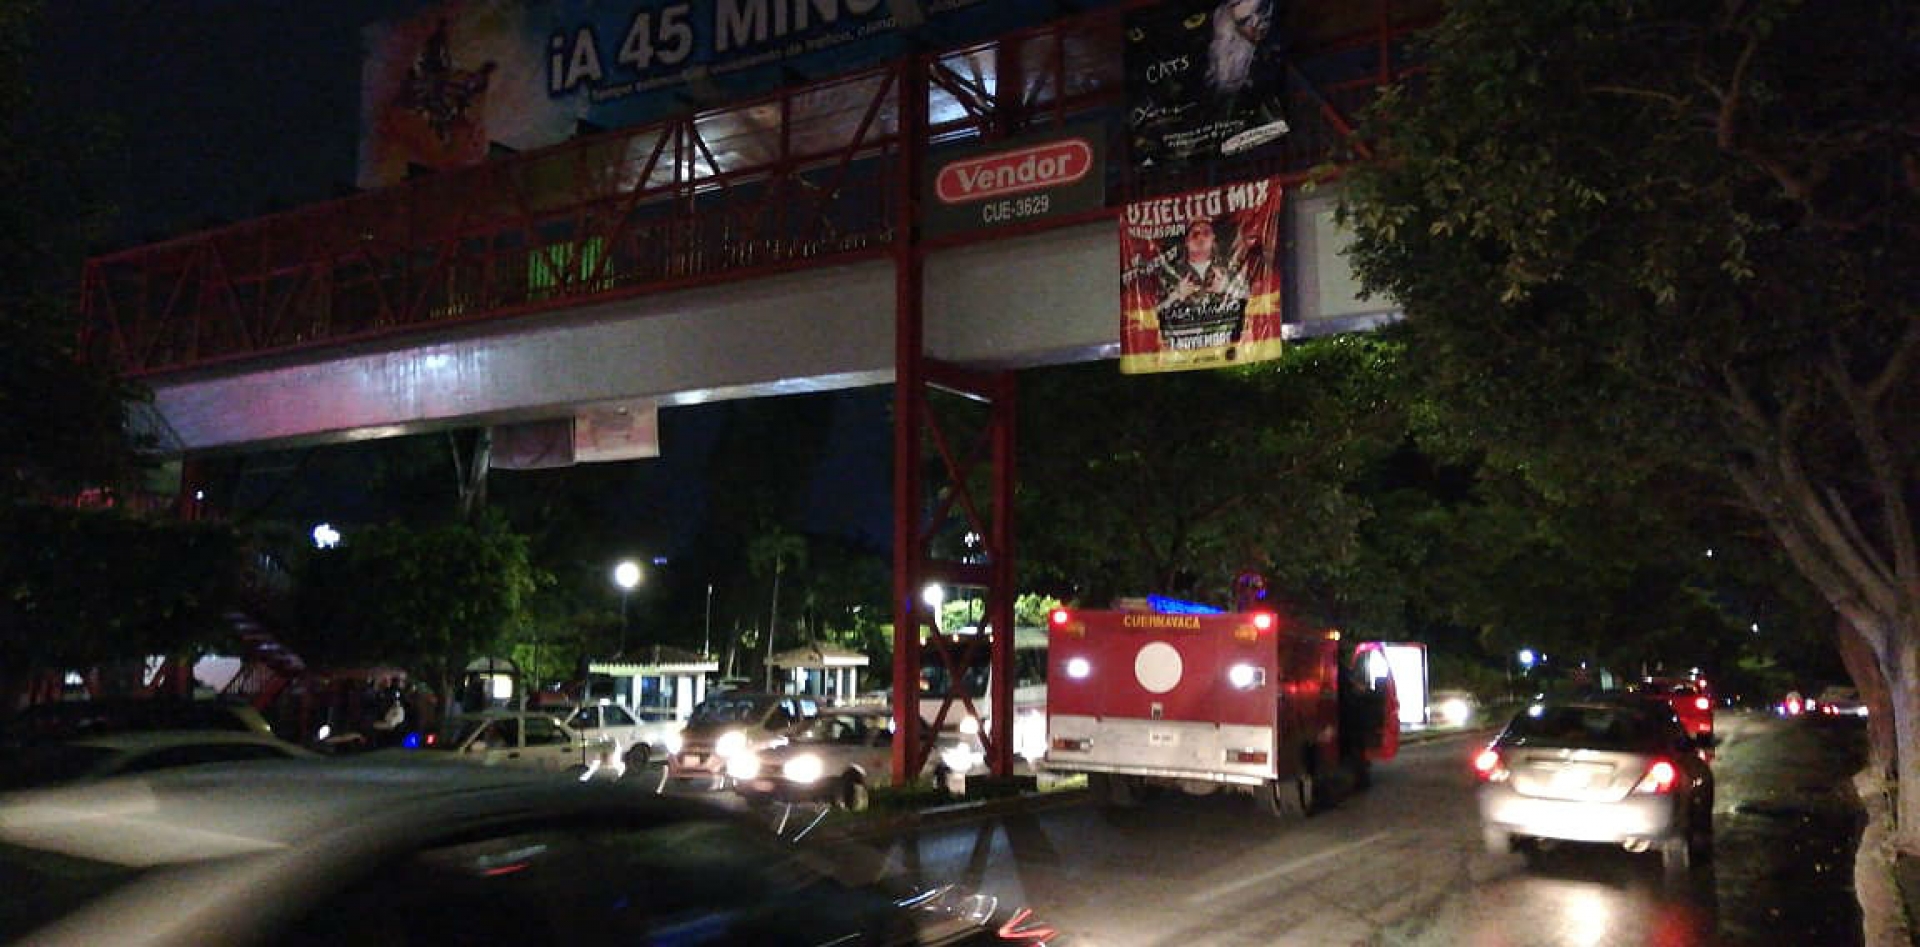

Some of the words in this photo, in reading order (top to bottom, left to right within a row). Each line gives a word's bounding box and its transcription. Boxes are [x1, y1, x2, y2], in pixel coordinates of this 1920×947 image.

[617, 4, 694, 71] 45
[714, 0, 884, 53] MIN
[1145, 53, 1190, 85] CATS
[956, 152, 1073, 194] Vendor
[982, 194, 1050, 224] CUE-3629
[1226, 178, 1270, 214] MIX
[1123, 613, 1201, 630] CUERNAVACA
